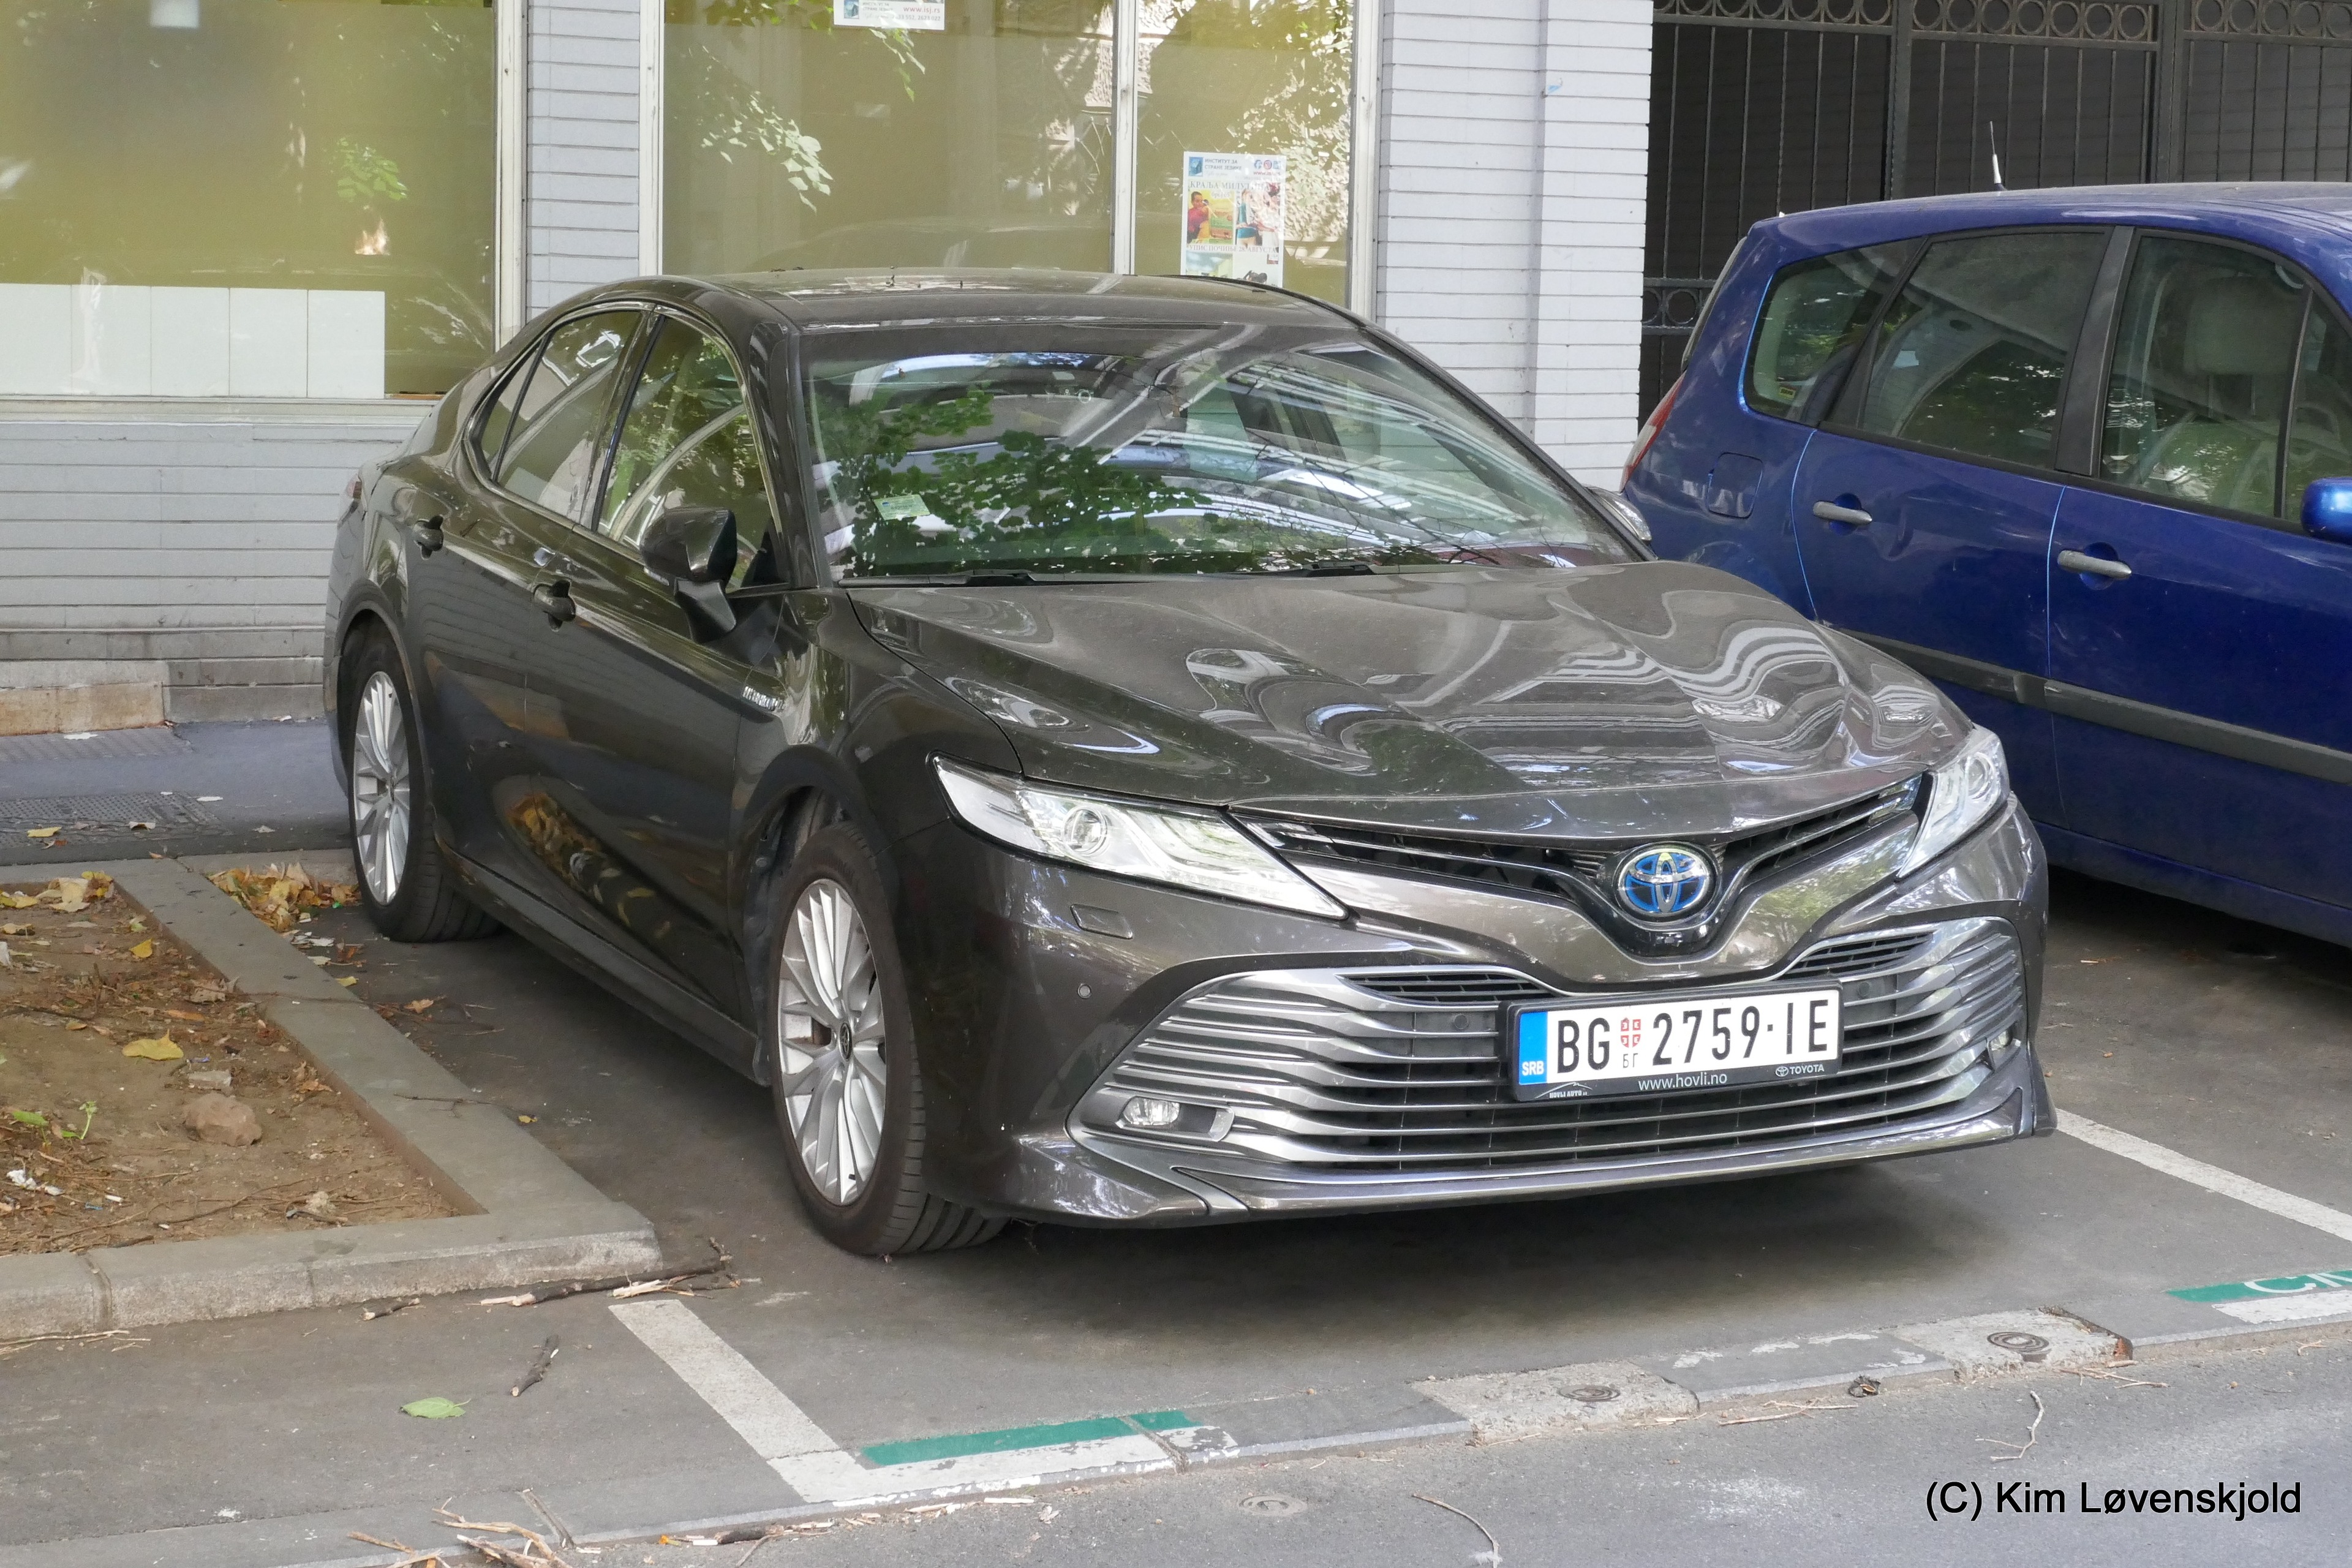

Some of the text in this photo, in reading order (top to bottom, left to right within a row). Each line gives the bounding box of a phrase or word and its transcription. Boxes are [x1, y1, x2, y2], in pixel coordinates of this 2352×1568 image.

[1556, 1017, 1610, 1074] BG
[1521, 1061, 1545, 1077] SRB
[1622, 1052, 1638, 1069] БГ
[1790, 1064, 1825, 1075] TOYOTA
[1638, 1072, 1728, 1091] www.hovli.no
